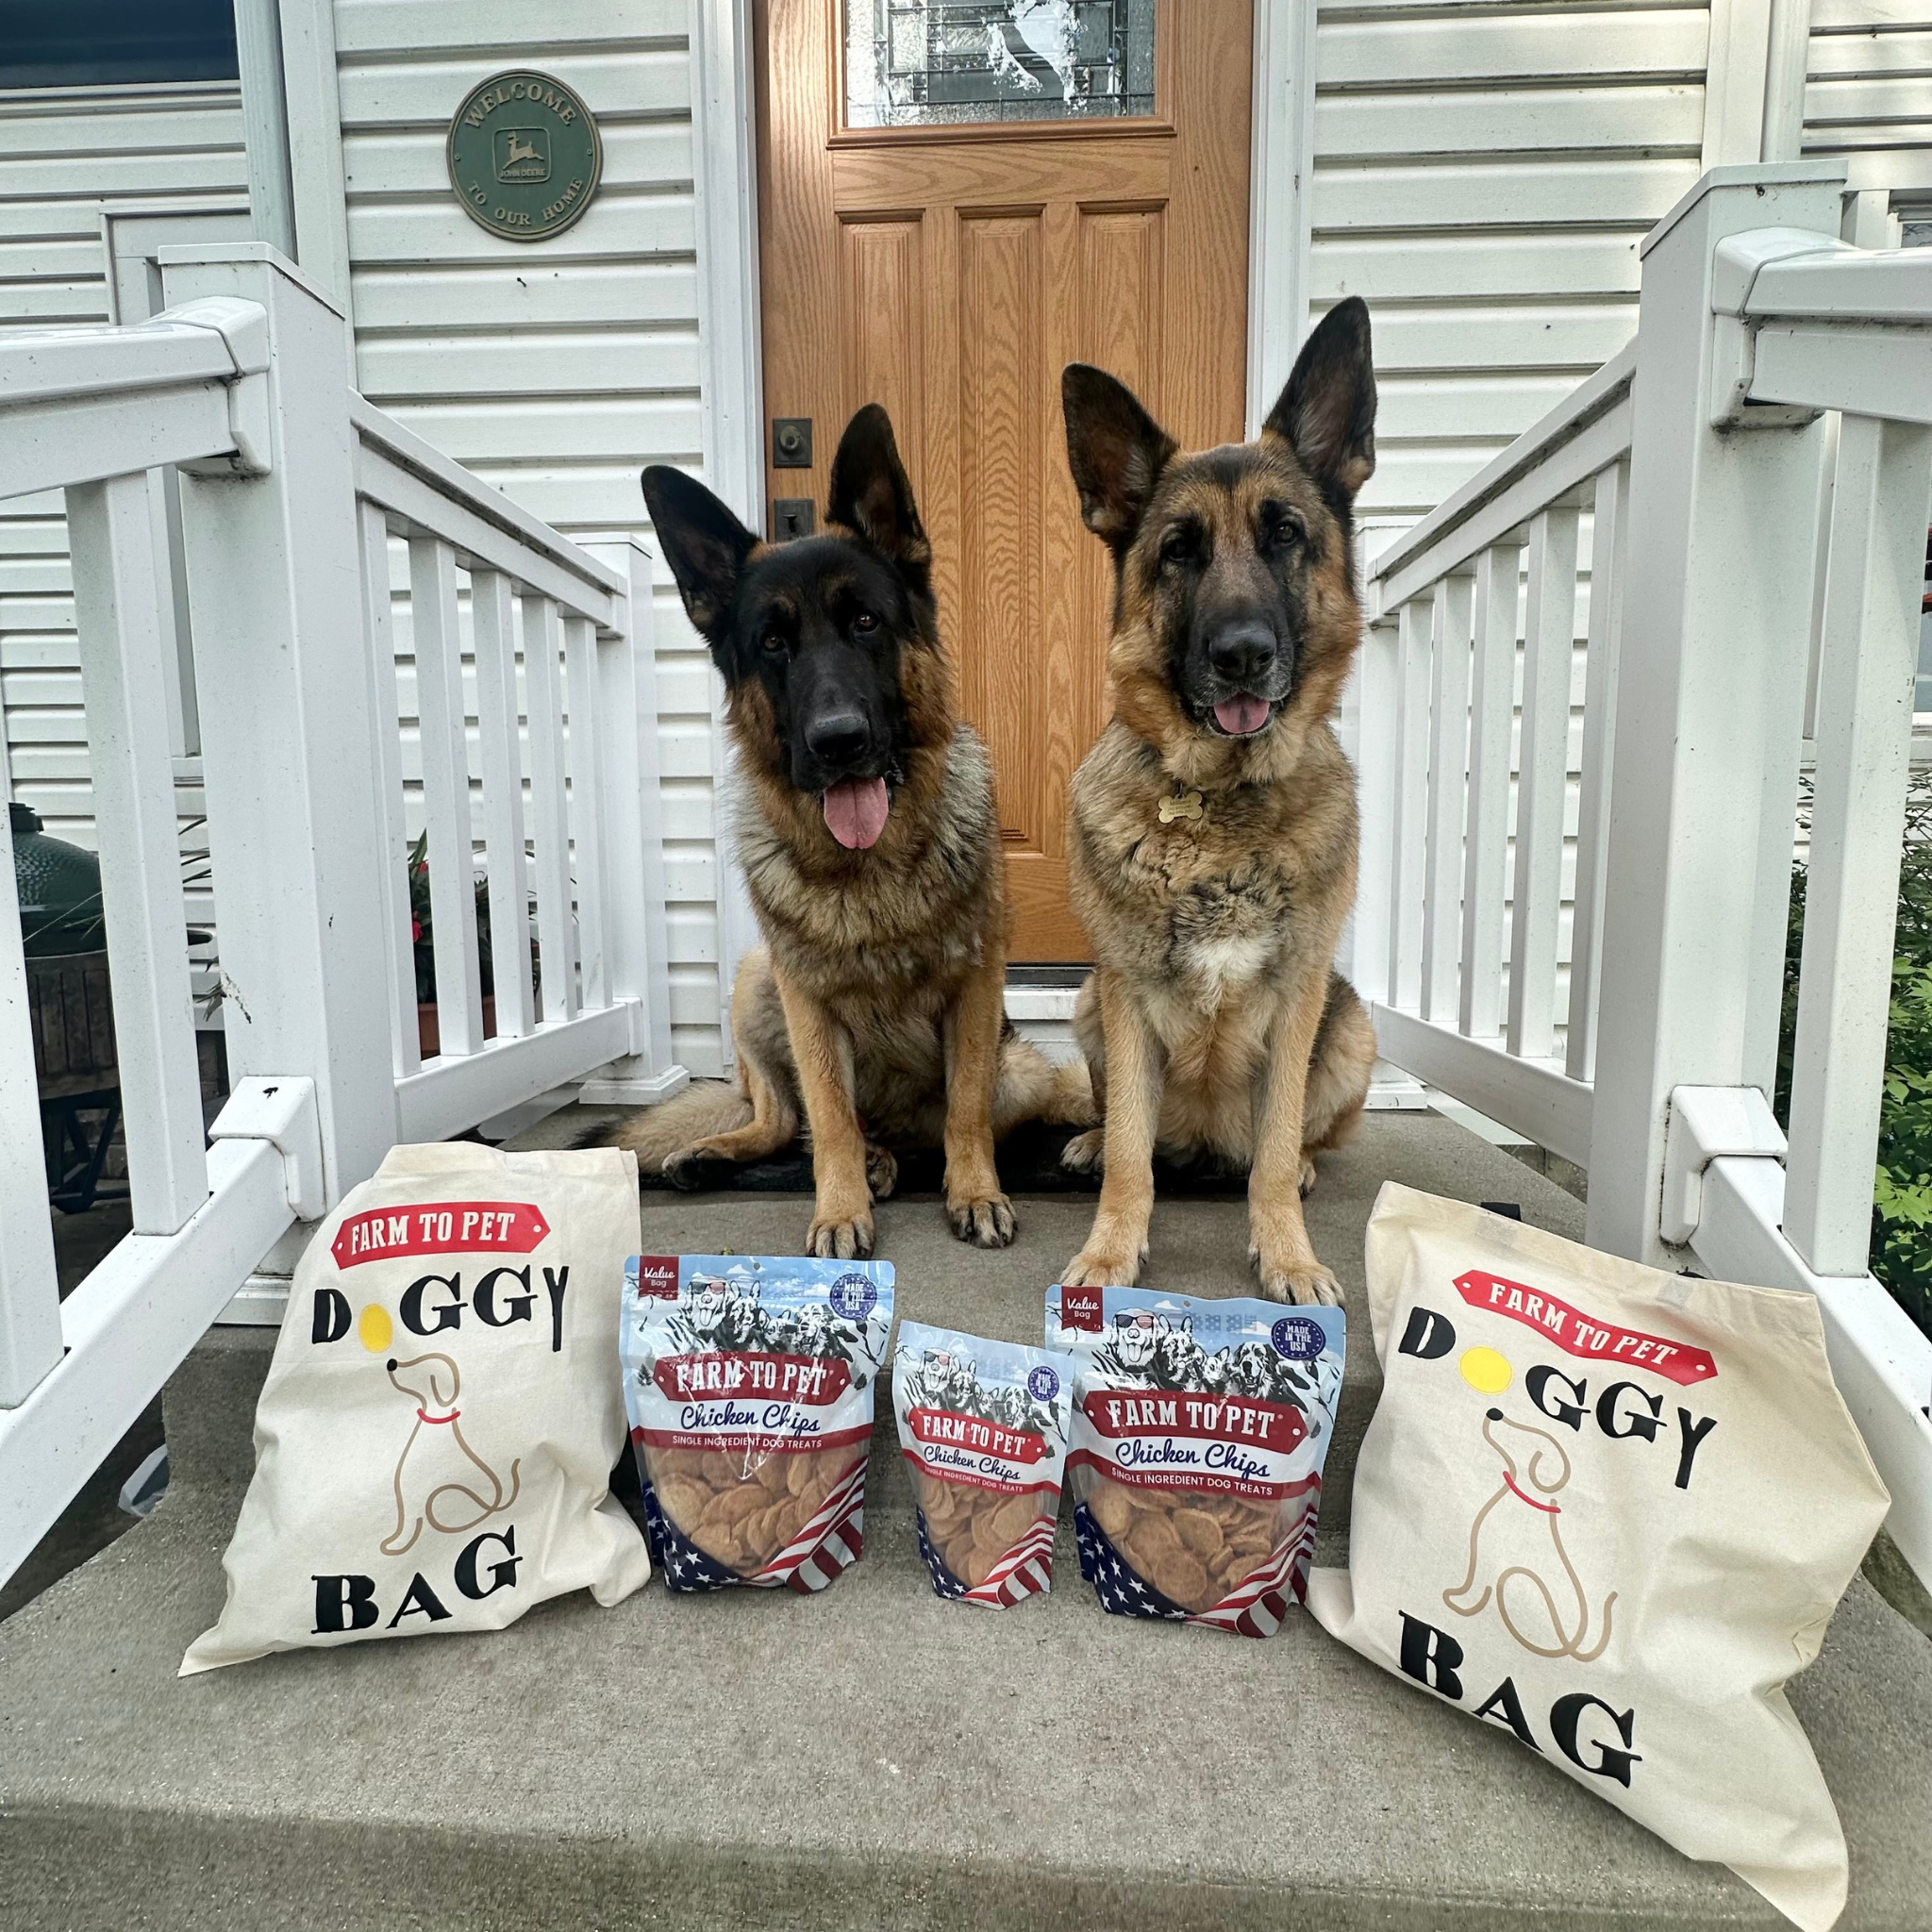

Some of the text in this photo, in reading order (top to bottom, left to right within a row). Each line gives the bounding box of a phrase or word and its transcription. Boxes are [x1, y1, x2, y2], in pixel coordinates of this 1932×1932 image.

[465, 82, 576, 128] WELCOME
[500, 168, 546, 178] JOHN DEERE
[469, 177, 583, 225] TO OUR HOME
[351, 1211, 515, 1256] FARM TO PET
[644, 1266, 675, 1279] Value
[651, 1280, 667, 1289] Bag
[846, 1302, 859, 1310] USA
[1067, 1296, 1099, 1310] Value
[1074, 1310, 1091, 1320] Bag
[1285, 1333, 1311, 1342] IN THE
[1287, 1324, 1309, 1335] MADE
[1489, 1282, 1678, 1366] FARM TO PET
[1290, 1341, 1307, 1352] USA
[676, 1361, 827, 1396] FARM TO PET
[680, 1401, 821, 1438] Chicken Chips
[1108, 1399, 1274, 1439] FARM TO PET
[673, 1436, 823, 1448] SINGLE INGREDIENT DOG TREATS
[923, 1415, 1026, 1456] FARM TO PET
[924, 1445, 1021, 1482] Chicken Chips
[1115, 1438, 1271, 1481] Chicken Chips
[943, 1470, 981, 1484] INGREDIENT
[982, 1480, 997, 1489] DOG
[999, 1484, 1024, 1492] TREATS
[1111, 1467, 1273, 1495] SINGLE INGREDIENT DOG TREATS
[311, 1524, 524, 1634] BAG
[1396, 1609, 1642, 1789] BAG
